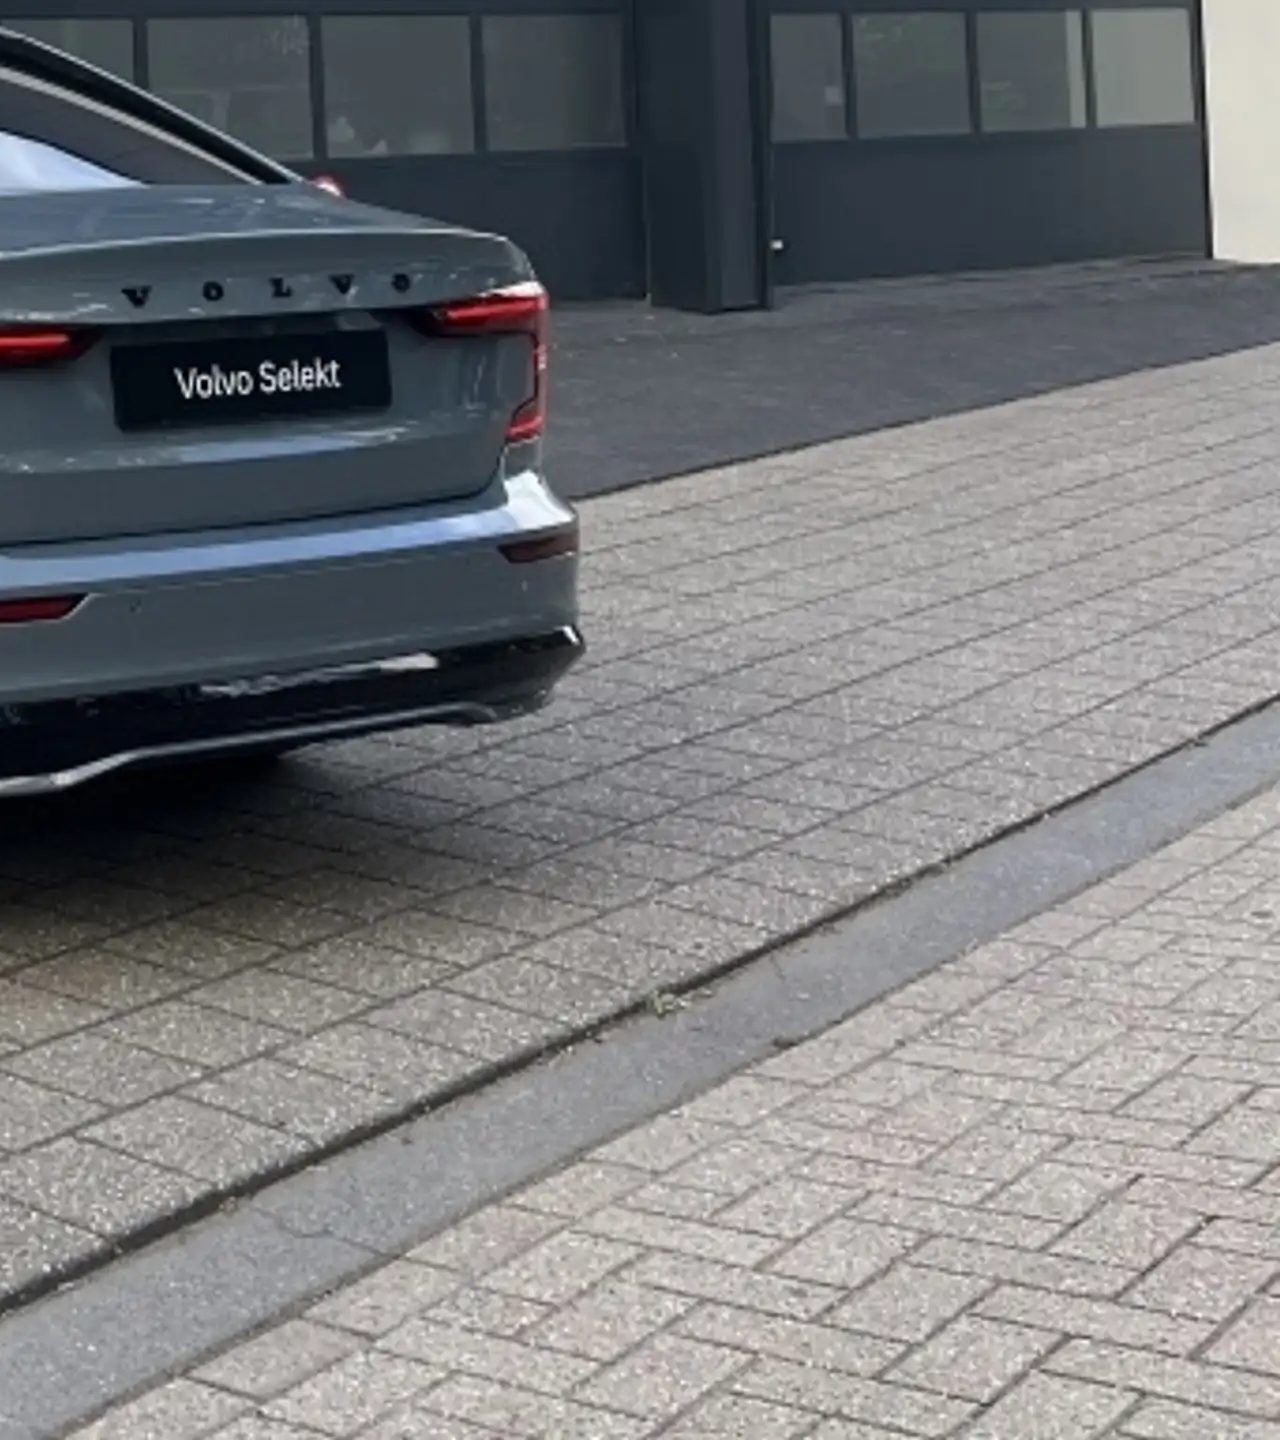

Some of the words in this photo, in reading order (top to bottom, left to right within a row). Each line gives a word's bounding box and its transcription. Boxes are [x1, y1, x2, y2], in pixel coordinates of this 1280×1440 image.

[121, 273, 412, 308] VOLVO
[174, 364, 254, 400] Volvo
[259, 358, 342, 393] Selekt
